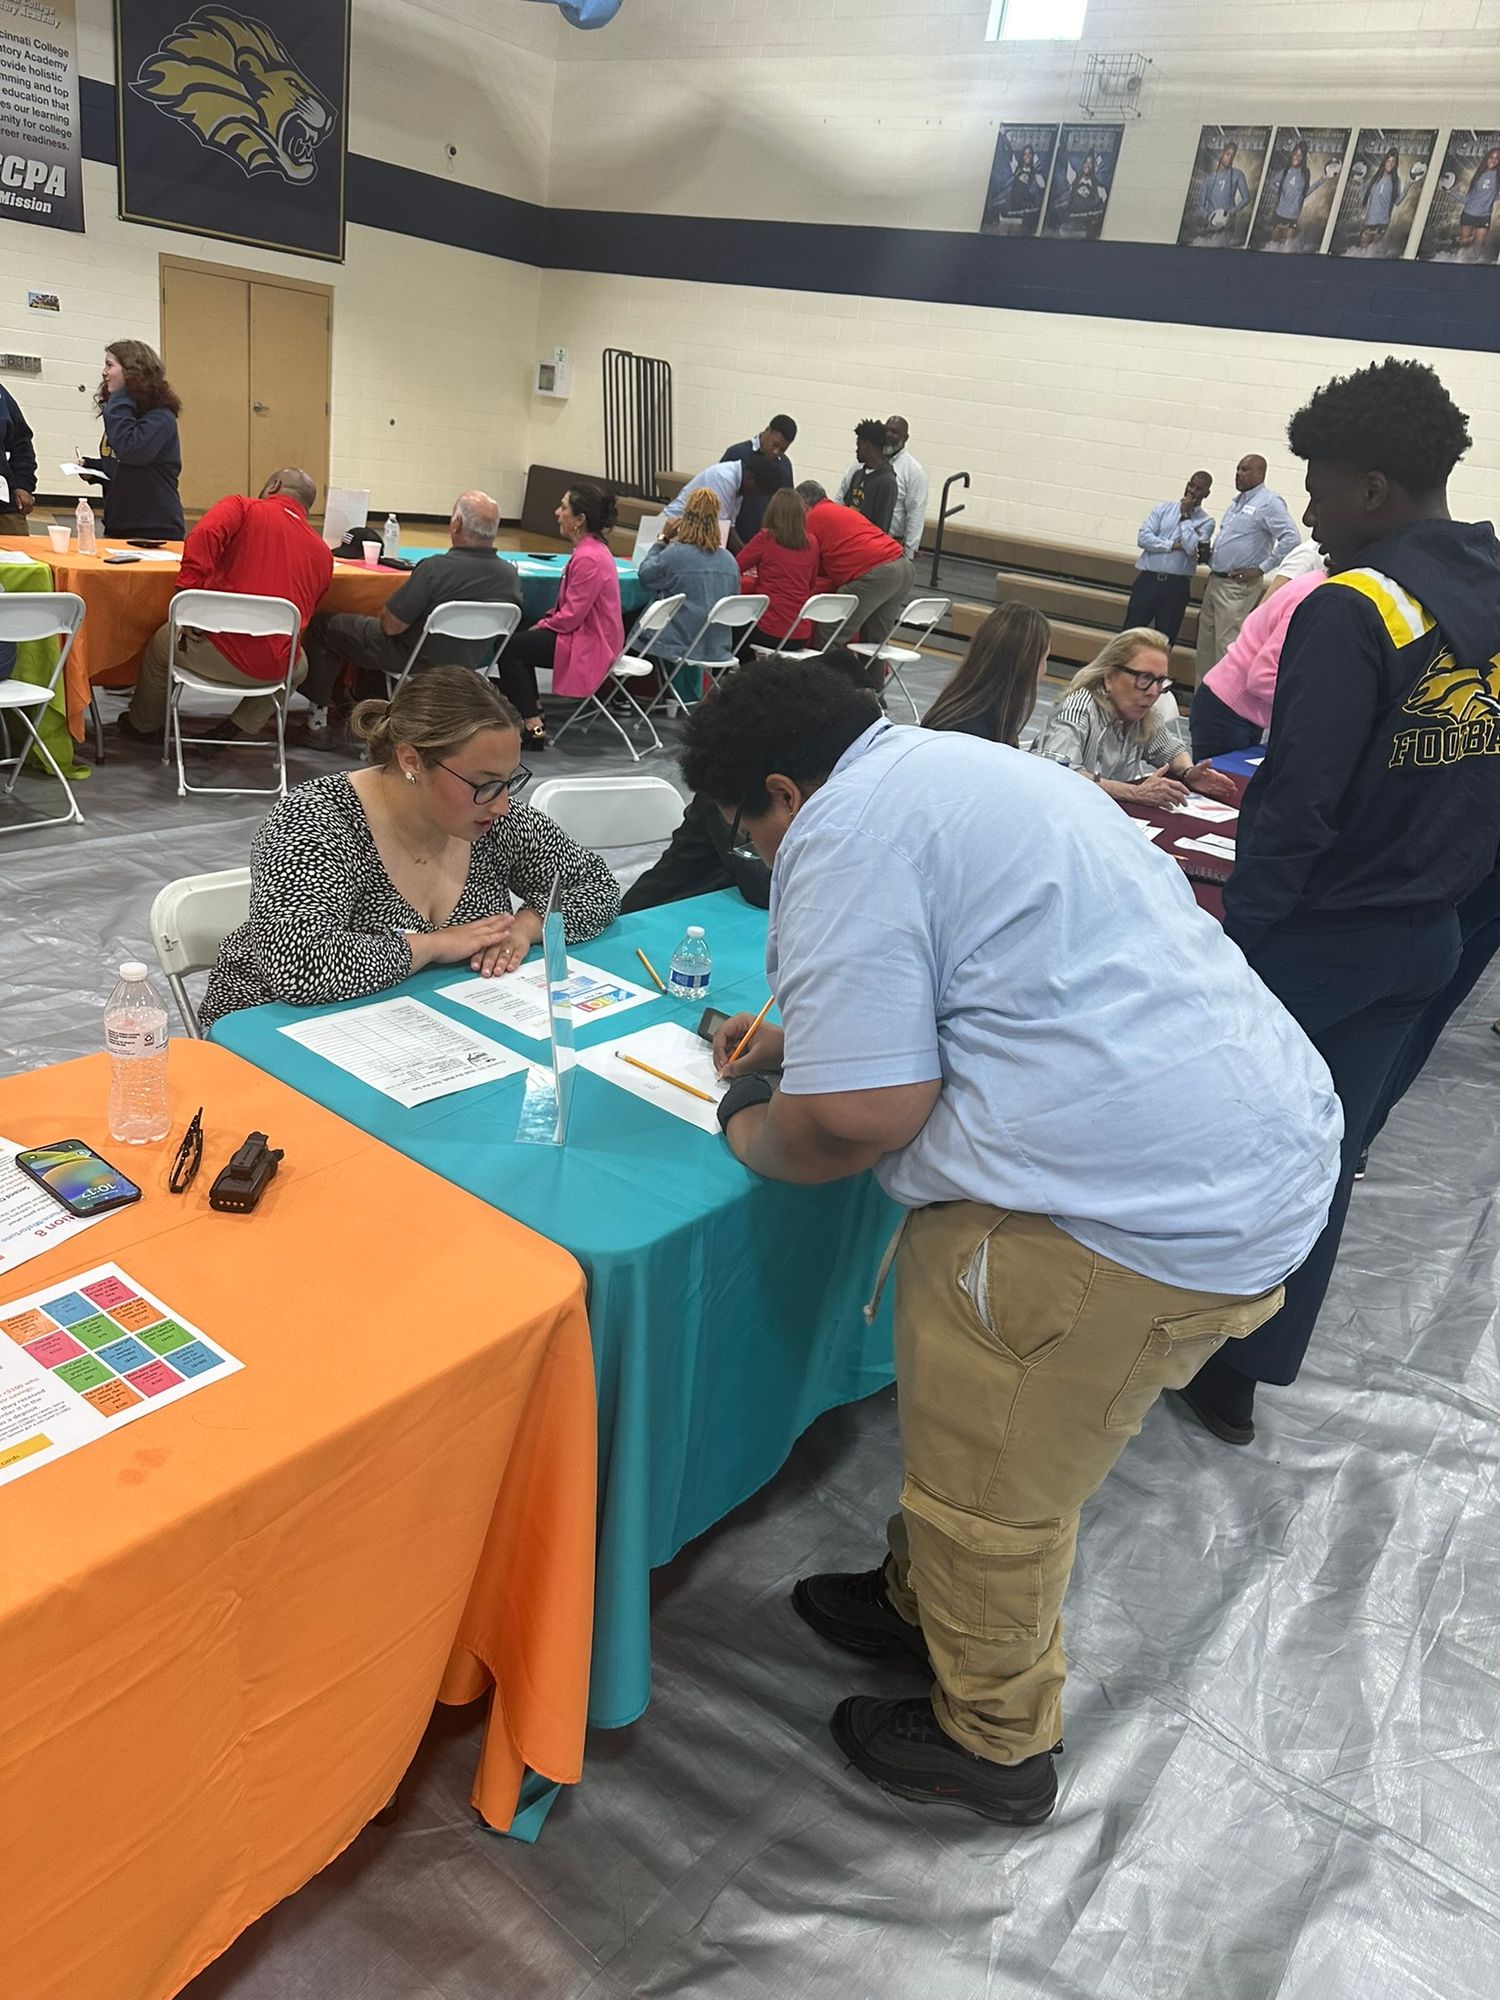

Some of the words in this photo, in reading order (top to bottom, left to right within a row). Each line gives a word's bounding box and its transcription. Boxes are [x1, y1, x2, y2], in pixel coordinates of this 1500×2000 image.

[33, 38, 69, 58] College
[24, 50, 68, 72] Academy
[29, 65, 63, 82] holistic
[2, 87, 49, 106] education
[52, 98, 70, 111] that
[33, 81, 52, 93] and
[54, 86, 69, 98] top
[14, 104, 30, 114] our
[33, 106, 70, 126] learning
[23, 118, 37, 129] for
[39, 123, 72, 139] college
[22, 133, 70, 151] readiness.
[0, 153, 67, 198] CPA
[34, 1229, 48, 1237] 8
